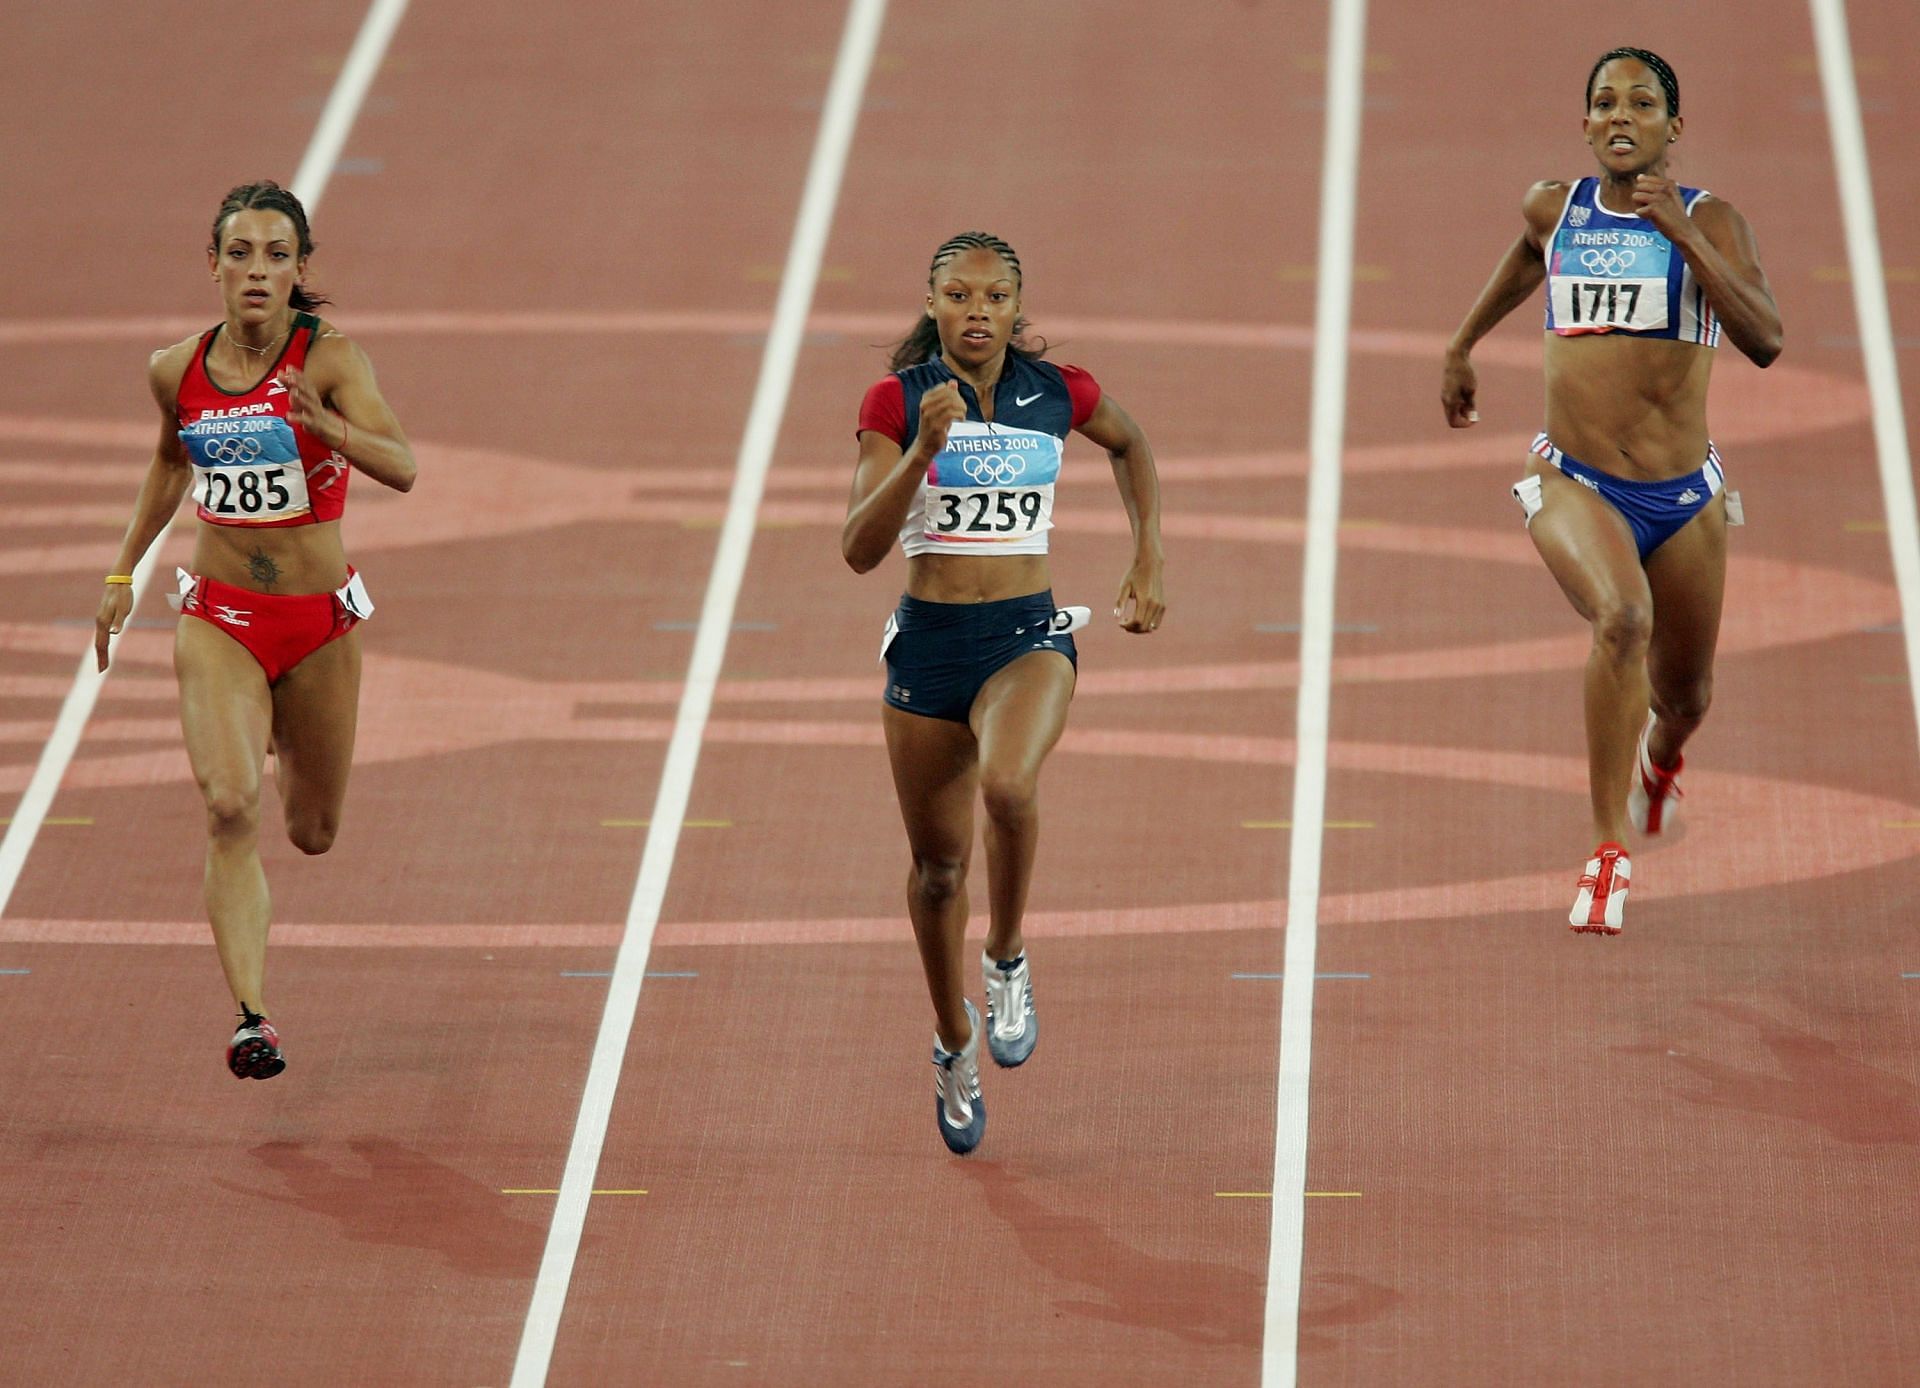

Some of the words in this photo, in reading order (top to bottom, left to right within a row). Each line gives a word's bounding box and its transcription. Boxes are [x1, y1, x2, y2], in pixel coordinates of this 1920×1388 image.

[1572, 232, 1619, 246] ATHENS
[1572, 283, 1642, 324] 1717
[200, 402, 274, 420] BULGARIA
[191, 421, 240, 435] ATHENS
[241, 420, 273, 433] 2004
[945, 438, 1002, 453] ATHENS
[1005, 437, 1039, 451] 2004
[204, 468, 289, 513] 1285
[937, 491, 1042, 532] 3259
